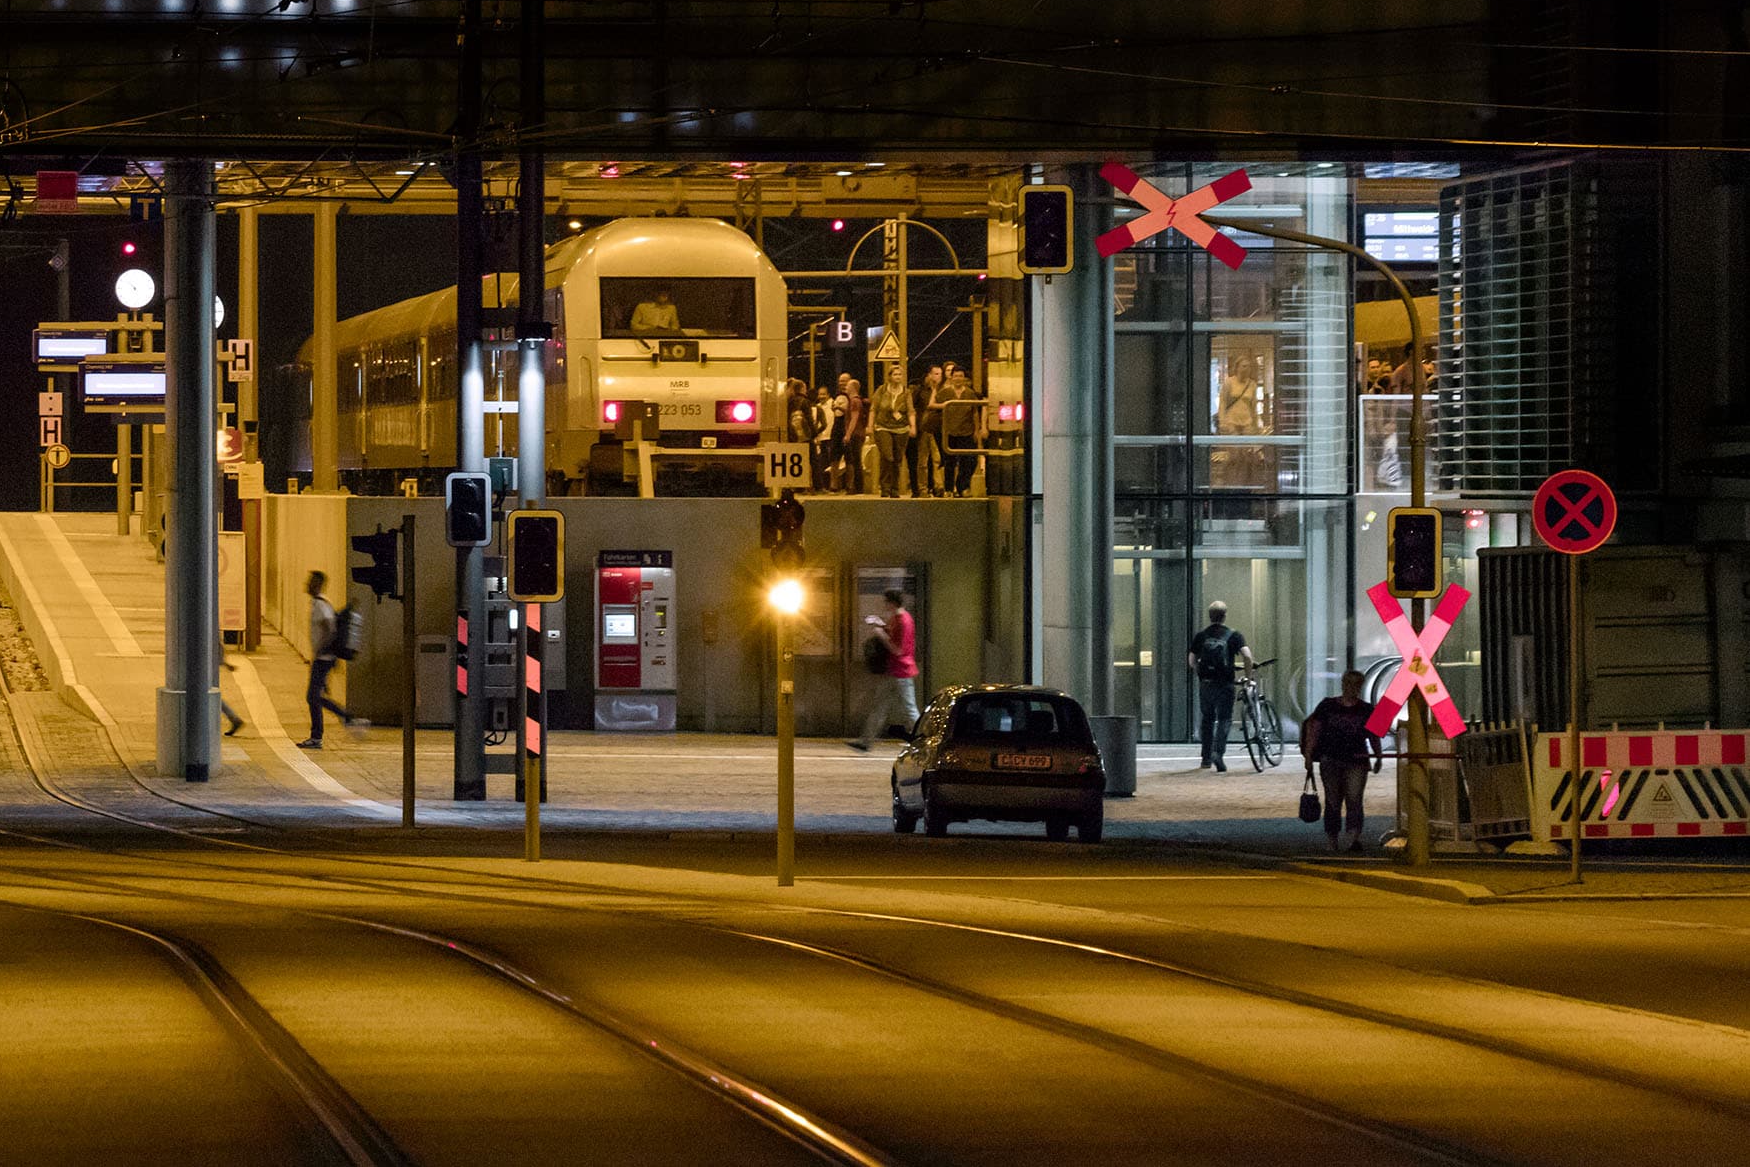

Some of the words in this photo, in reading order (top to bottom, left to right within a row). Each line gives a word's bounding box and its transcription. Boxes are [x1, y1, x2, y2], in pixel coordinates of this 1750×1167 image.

[136, 197, 156, 221] T
[837, 321, 853, 342] B
[680, 404, 702, 416] 053
[43, 419, 58, 447] H
[770, 452, 804, 478] H8
